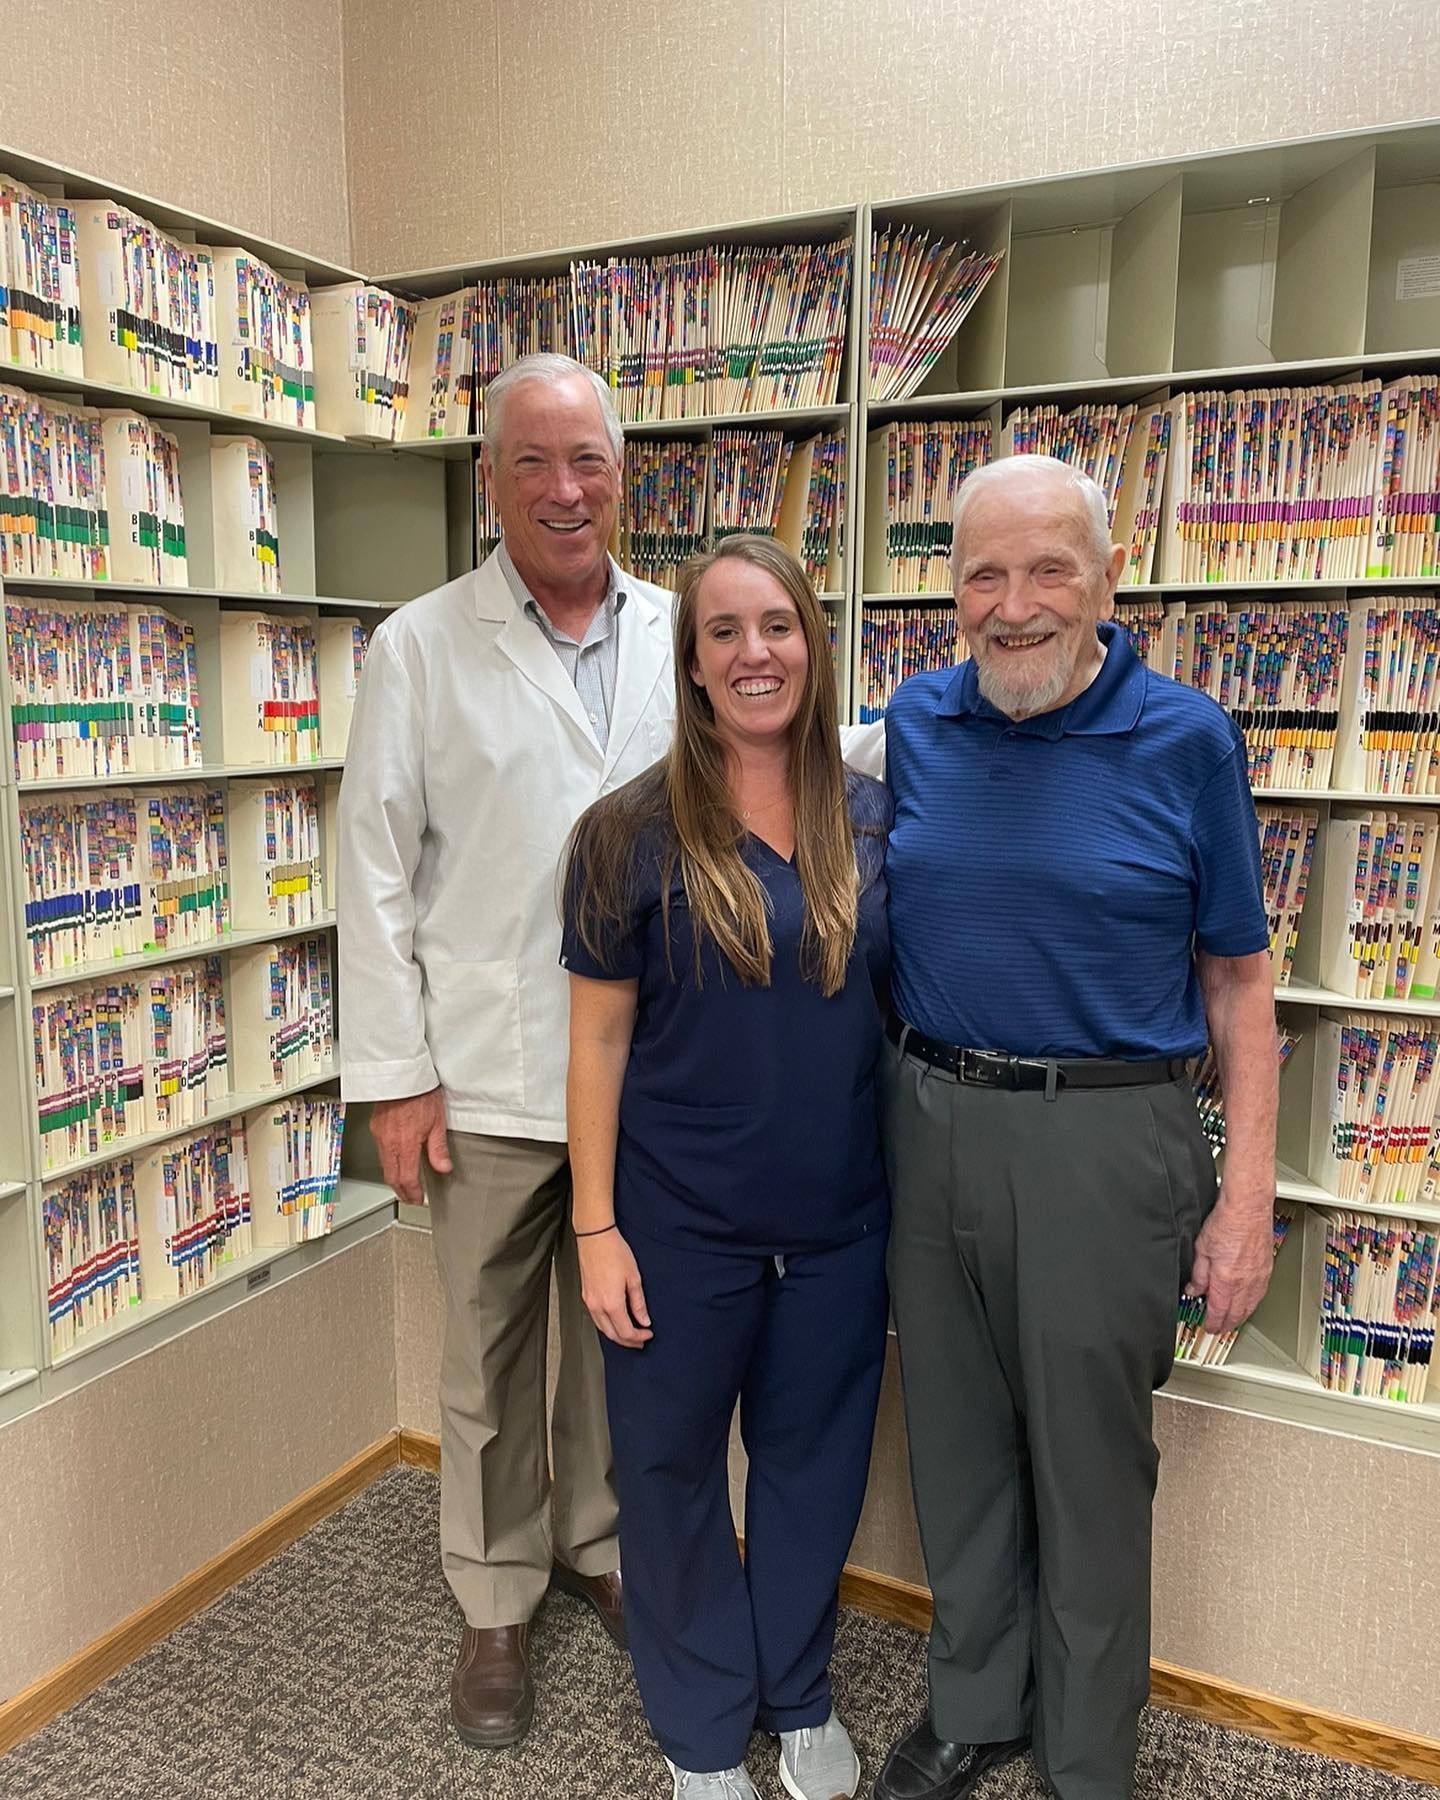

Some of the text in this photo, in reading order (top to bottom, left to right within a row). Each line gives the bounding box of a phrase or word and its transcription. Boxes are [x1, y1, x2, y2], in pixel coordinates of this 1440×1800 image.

[110, 312, 116, 323] H
[110, 330, 116, 342] E
[238, 366, 243, 377] O
[132, 514, 138, 525] B
[132, 532, 138, 542] E
[249, 531, 254, 540] B
[140, 706, 144, 717] E
[152, 706, 157, 716] E
[188, 708, 192, 719] E
[258, 704, 262, 714] F
[152, 723, 158, 734] L
[258, 719, 262, 728] A
[140, 724, 146, 734] L
[265, 871, 272, 880] K
[150, 888, 156, 898] K
[152, 905, 158, 915] A
[1288, 914, 1294, 925] M
[1348, 923, 1355, 935] M
[1381, 926, 1388, 938] M
[1398, 922, 1405, 934] M
[320, 1008, 326, 1018] P
[309, 1016, 314, 1026] P
[321, 1024, 326, 1032] Y
[270, 1036, 276, 1044] P
[310, 1032, 314, 1040] R
[270, 1051, 276, 1060] R
[182, 1060, 188, 1071] P
[154, 1067, 158, 1078] P
[1428, 1146, 1435, 1158] A
[165, 1239, 170, 1249] S
